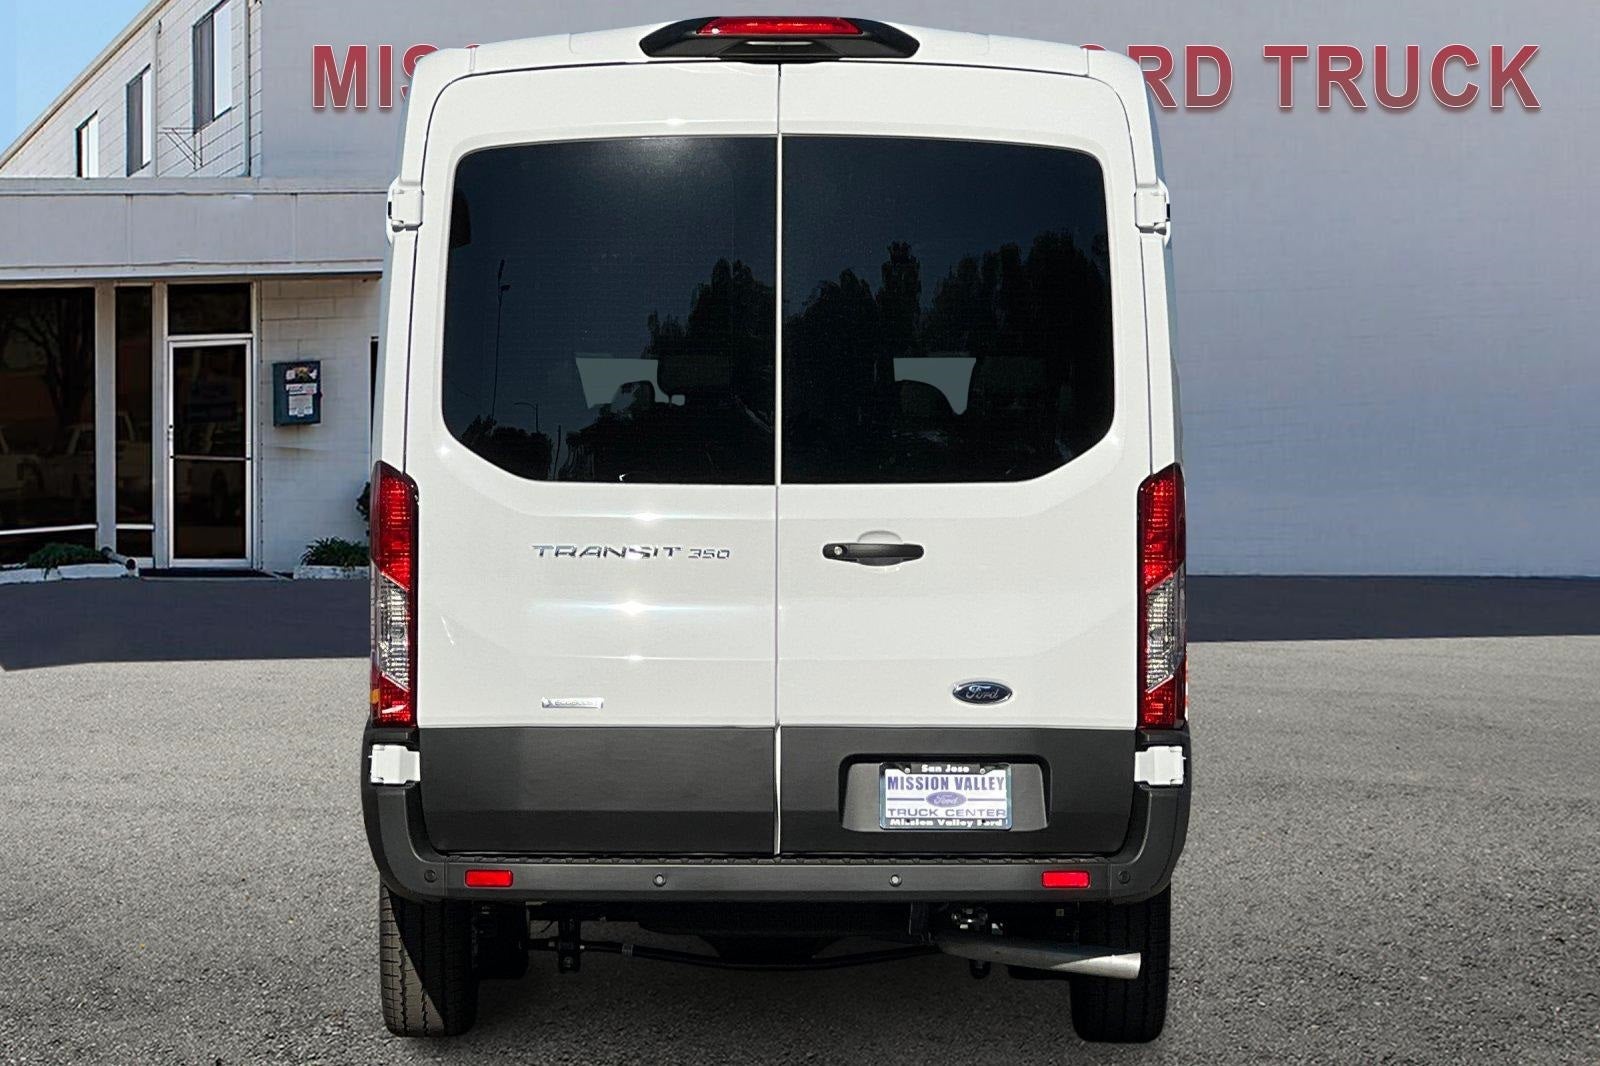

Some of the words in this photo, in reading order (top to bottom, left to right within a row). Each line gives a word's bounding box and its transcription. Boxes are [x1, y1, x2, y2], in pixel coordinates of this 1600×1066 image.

[313, 44, 480, 108] MI
[1080, 44, 1233, 108] RD
[1263, 44, 1541, 108] TRUCK
[532, 545, 682, 559] TRANSIT
[688, 549, 731, 559] 350
[921, 764, 942, 773] San
[887, 776, 949, 791] MISSION
[954, 776, 1005, 791] VALLEY
[887, 808, 939, 817] TRUCK
[945, 808, 1006, 817] CENTER
[937, 818, 974, 828] Valley
